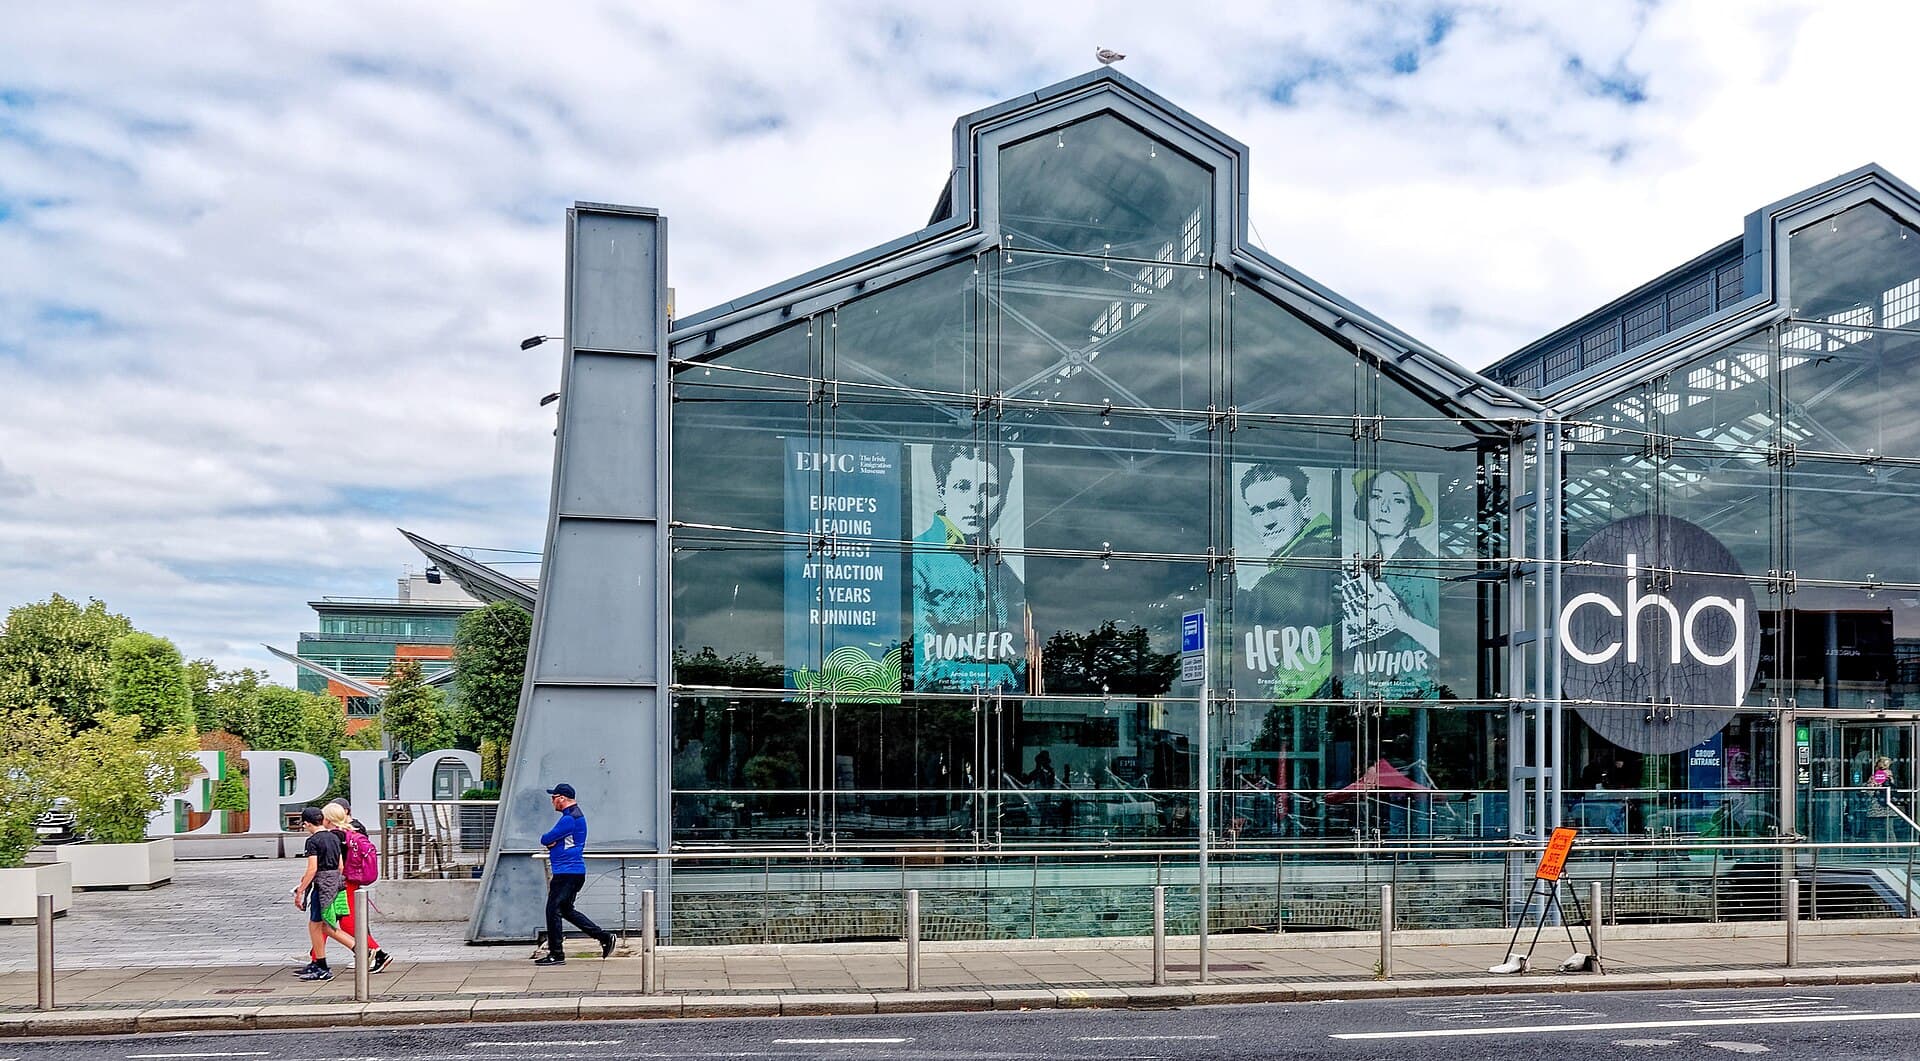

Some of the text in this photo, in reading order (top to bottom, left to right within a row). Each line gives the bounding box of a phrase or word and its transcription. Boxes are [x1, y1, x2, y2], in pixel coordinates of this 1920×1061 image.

[796, 452, 855, 473] EPIC
[810, 495, 877, 513] EUROPE'S
[815, 518, 872, 535] LEADING
[828, 587, 872, 603] YEARS
[810, 609, 877, 626] RUNNING!
[1560, 554, 1745, 707] chq
[923, 631, 1016, 661] PIONEER
[1245, 624, 1322, 673] HERO
[1353, 650, 1428, 676] AUTHOR
[1690, 758, 1721, 767] ENTRANCE
[1694, 749, 1716, 758] GROUP
